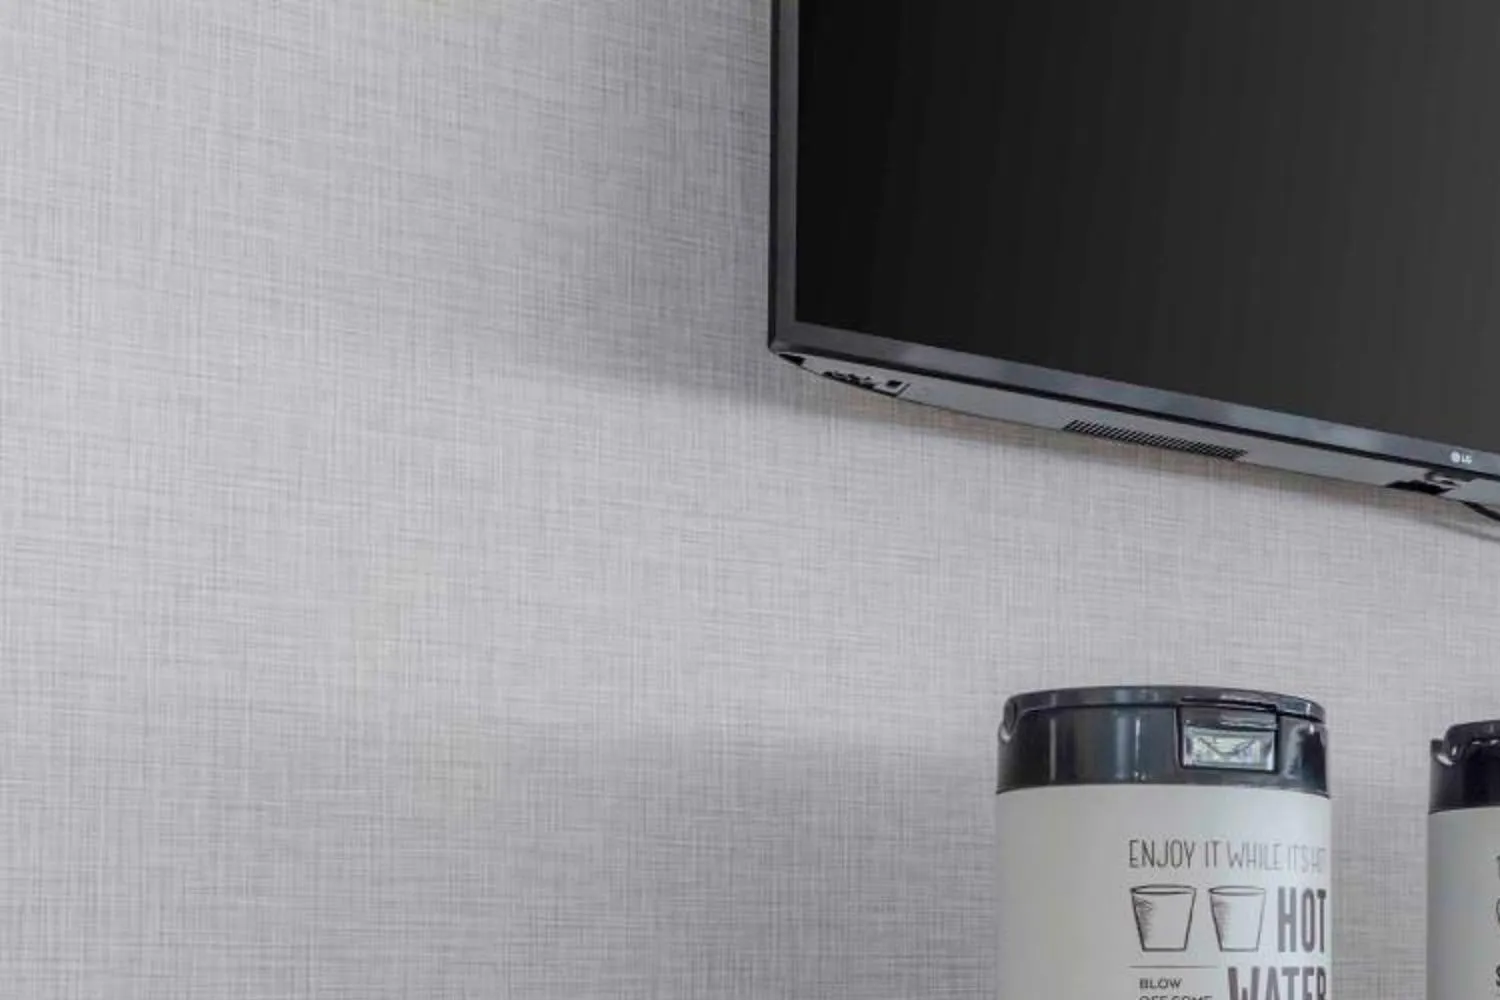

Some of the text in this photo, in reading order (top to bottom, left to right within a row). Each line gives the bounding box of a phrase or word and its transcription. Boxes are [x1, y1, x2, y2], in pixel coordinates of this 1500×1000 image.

[1129, 839, 1195, 869] ENJOY
[1204, 840, 1220, 868] IT
[1226, 841, 1281, 871] WHILE
[1277, 886, 1327, 953] HOT
[1139, 978, 1182, 989] BLOW
